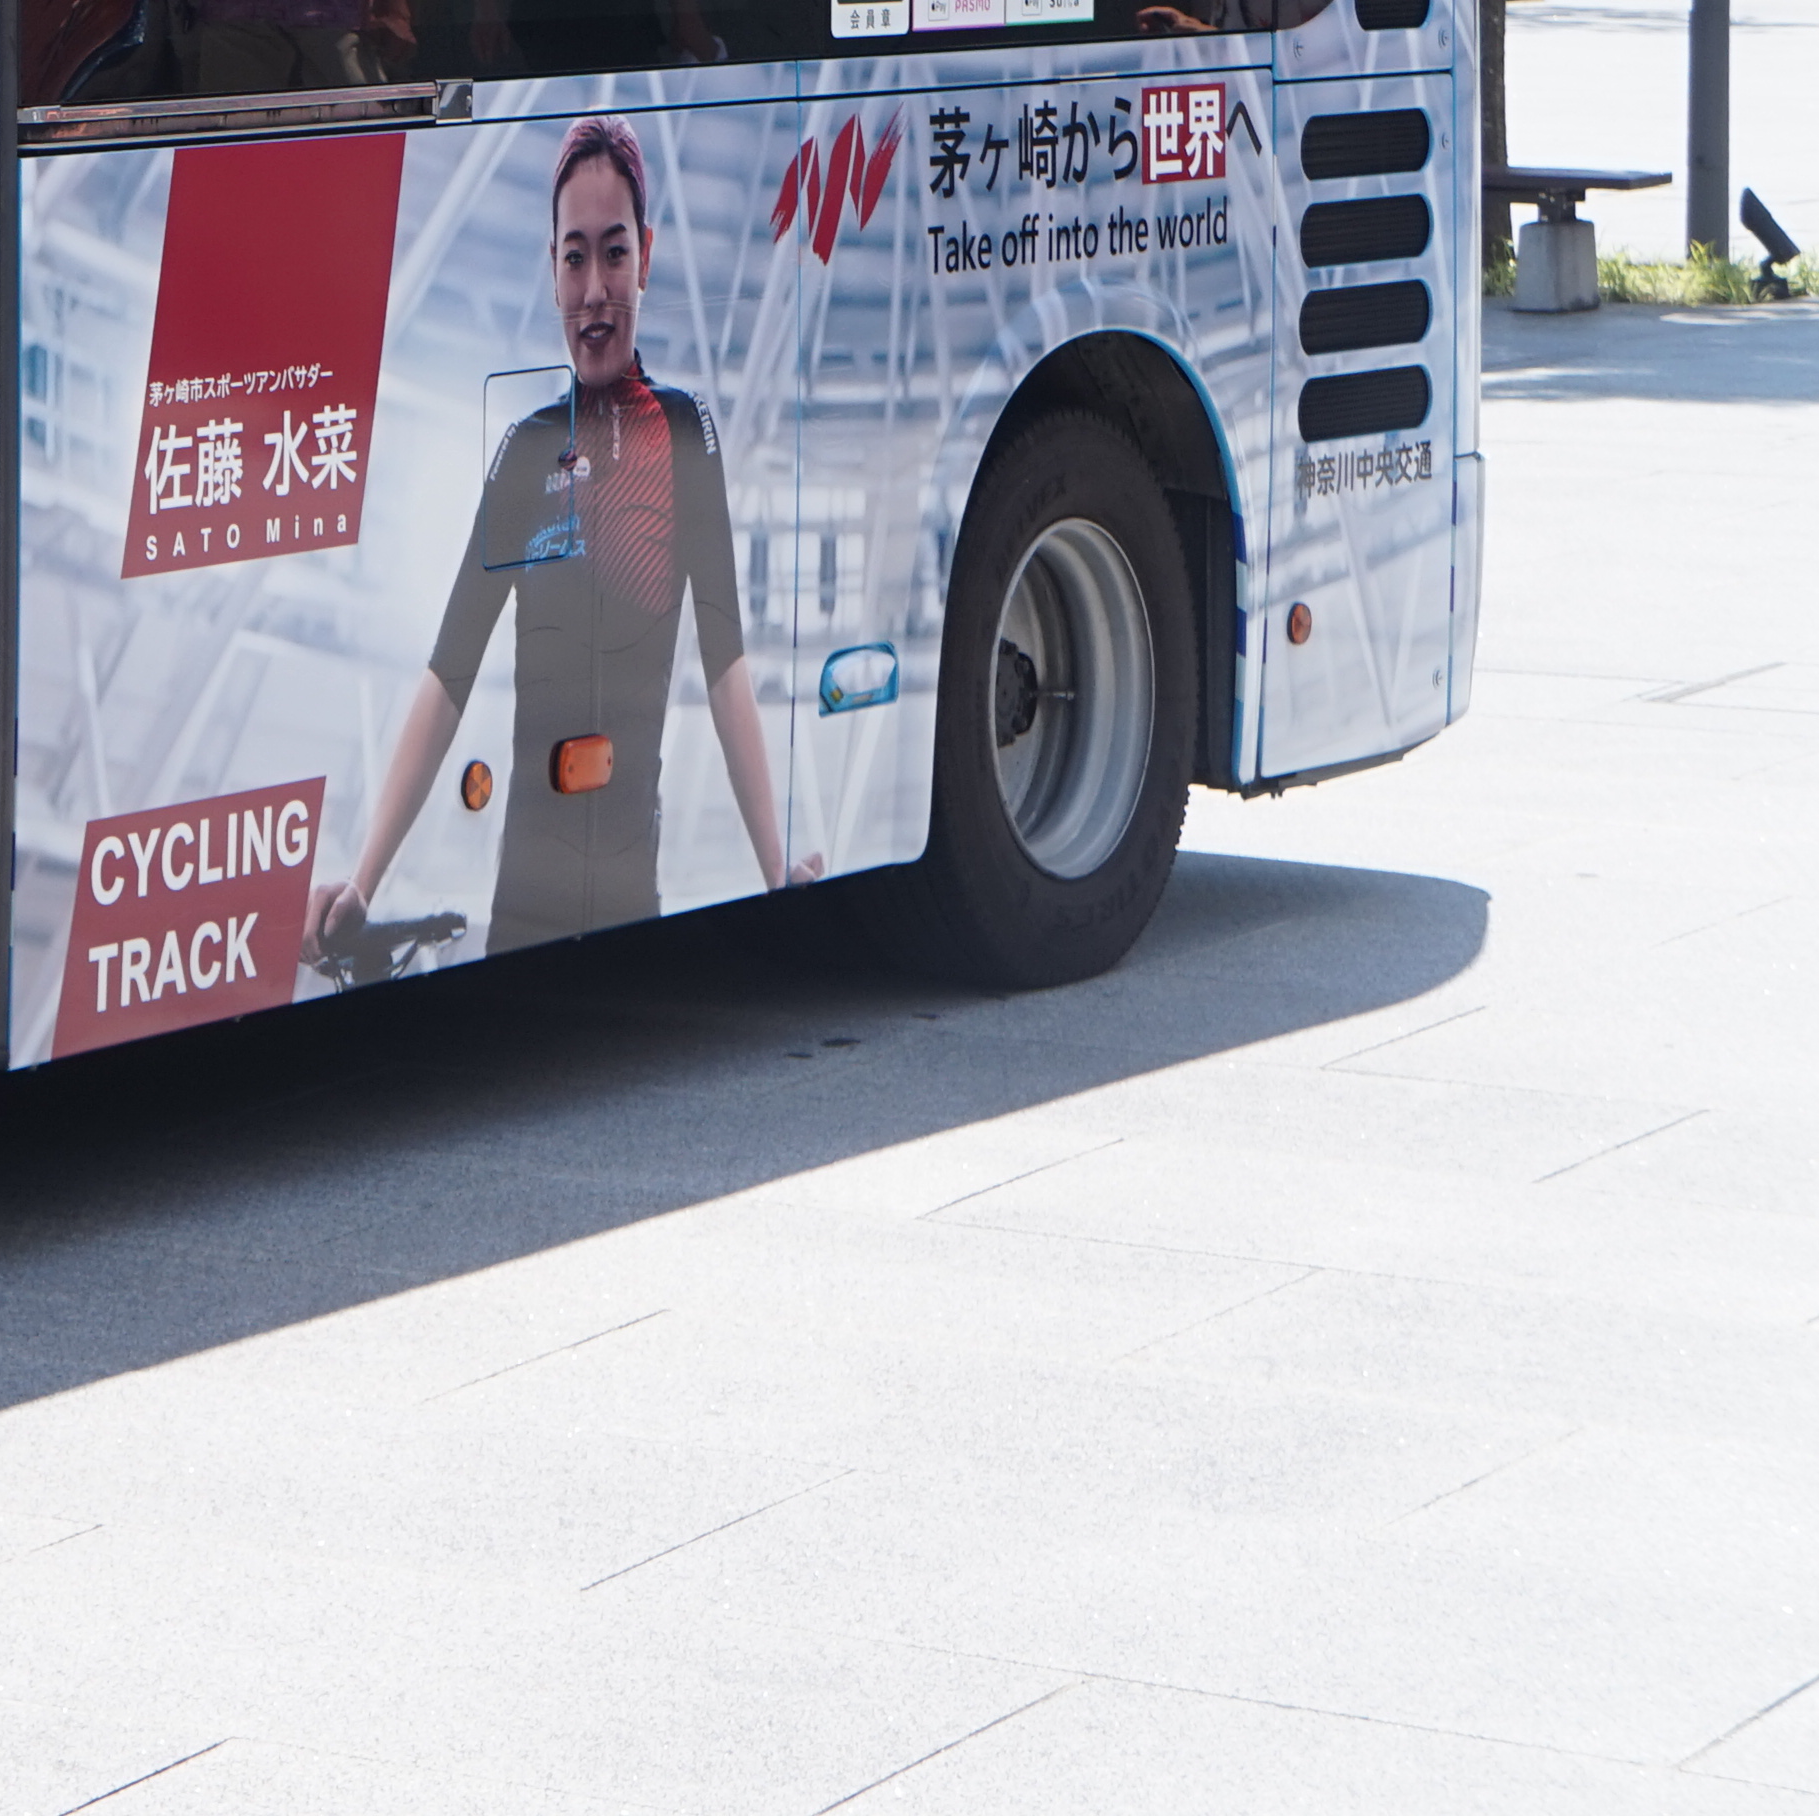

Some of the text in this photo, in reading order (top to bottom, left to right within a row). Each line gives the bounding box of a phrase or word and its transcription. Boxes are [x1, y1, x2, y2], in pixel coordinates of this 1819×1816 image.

[850, 8, 891, 30] 会員章
[928, 195, 1228, 274] Take off into the world
[144, 403, 358, 515] 佐藤 水菜
[1296, 439, 1433, 500] 神奈川中央交通
[145, 512, 348, 561] SATO Mina
[90, 798, 310, 907] CYCLING
[88, 911, 259, 1013] TRACK
